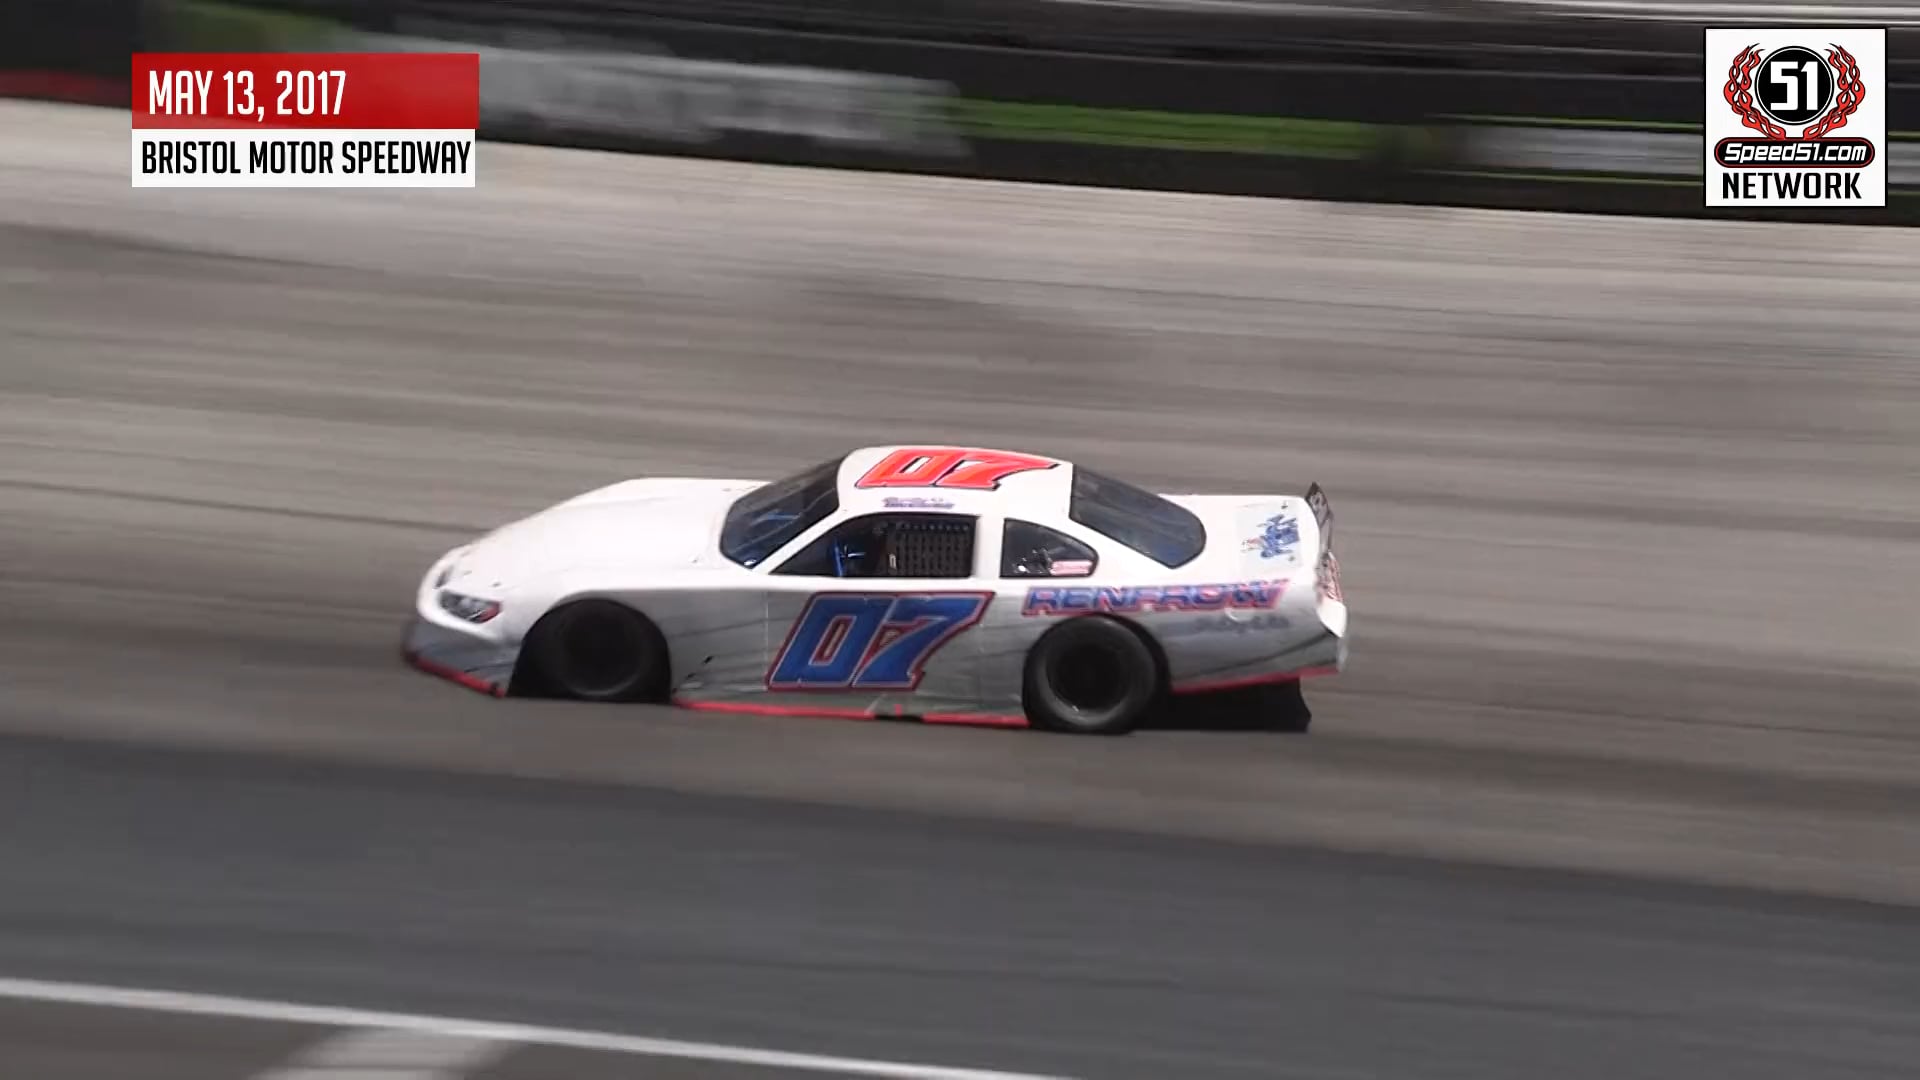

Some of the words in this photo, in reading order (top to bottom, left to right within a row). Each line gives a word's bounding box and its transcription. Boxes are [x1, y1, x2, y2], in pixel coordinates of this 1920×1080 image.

[855, 449, 1059, 491] 07
[1022, 578, 1290, 616] RENFROW
[765, 591, 995, 692] 07
